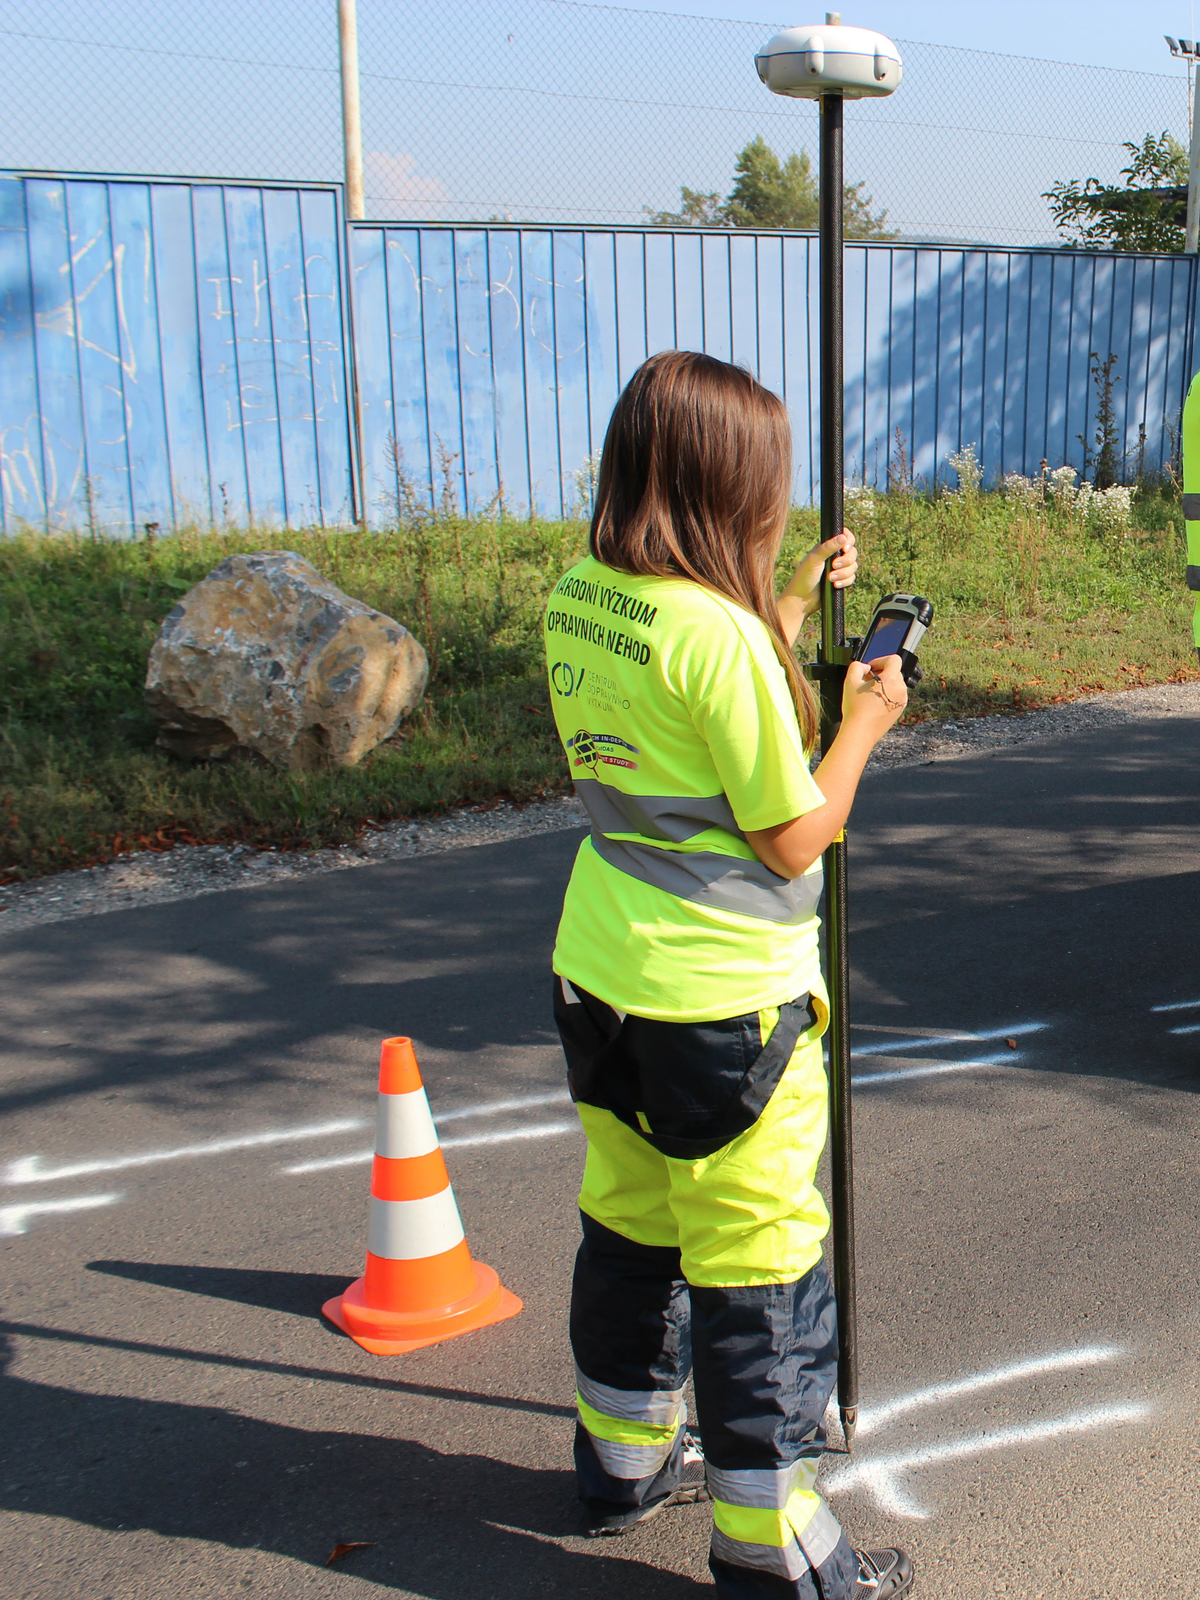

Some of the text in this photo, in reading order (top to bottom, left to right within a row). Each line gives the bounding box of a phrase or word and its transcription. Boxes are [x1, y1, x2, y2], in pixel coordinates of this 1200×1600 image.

[600, 586, 657, 627] VÝZKUM
[546, 611, 651, 666] OPRAVNÍCH NEHOD
[588, 670, 617, 692] CENTRUM
[609, 757, 630, 767] STUDY
